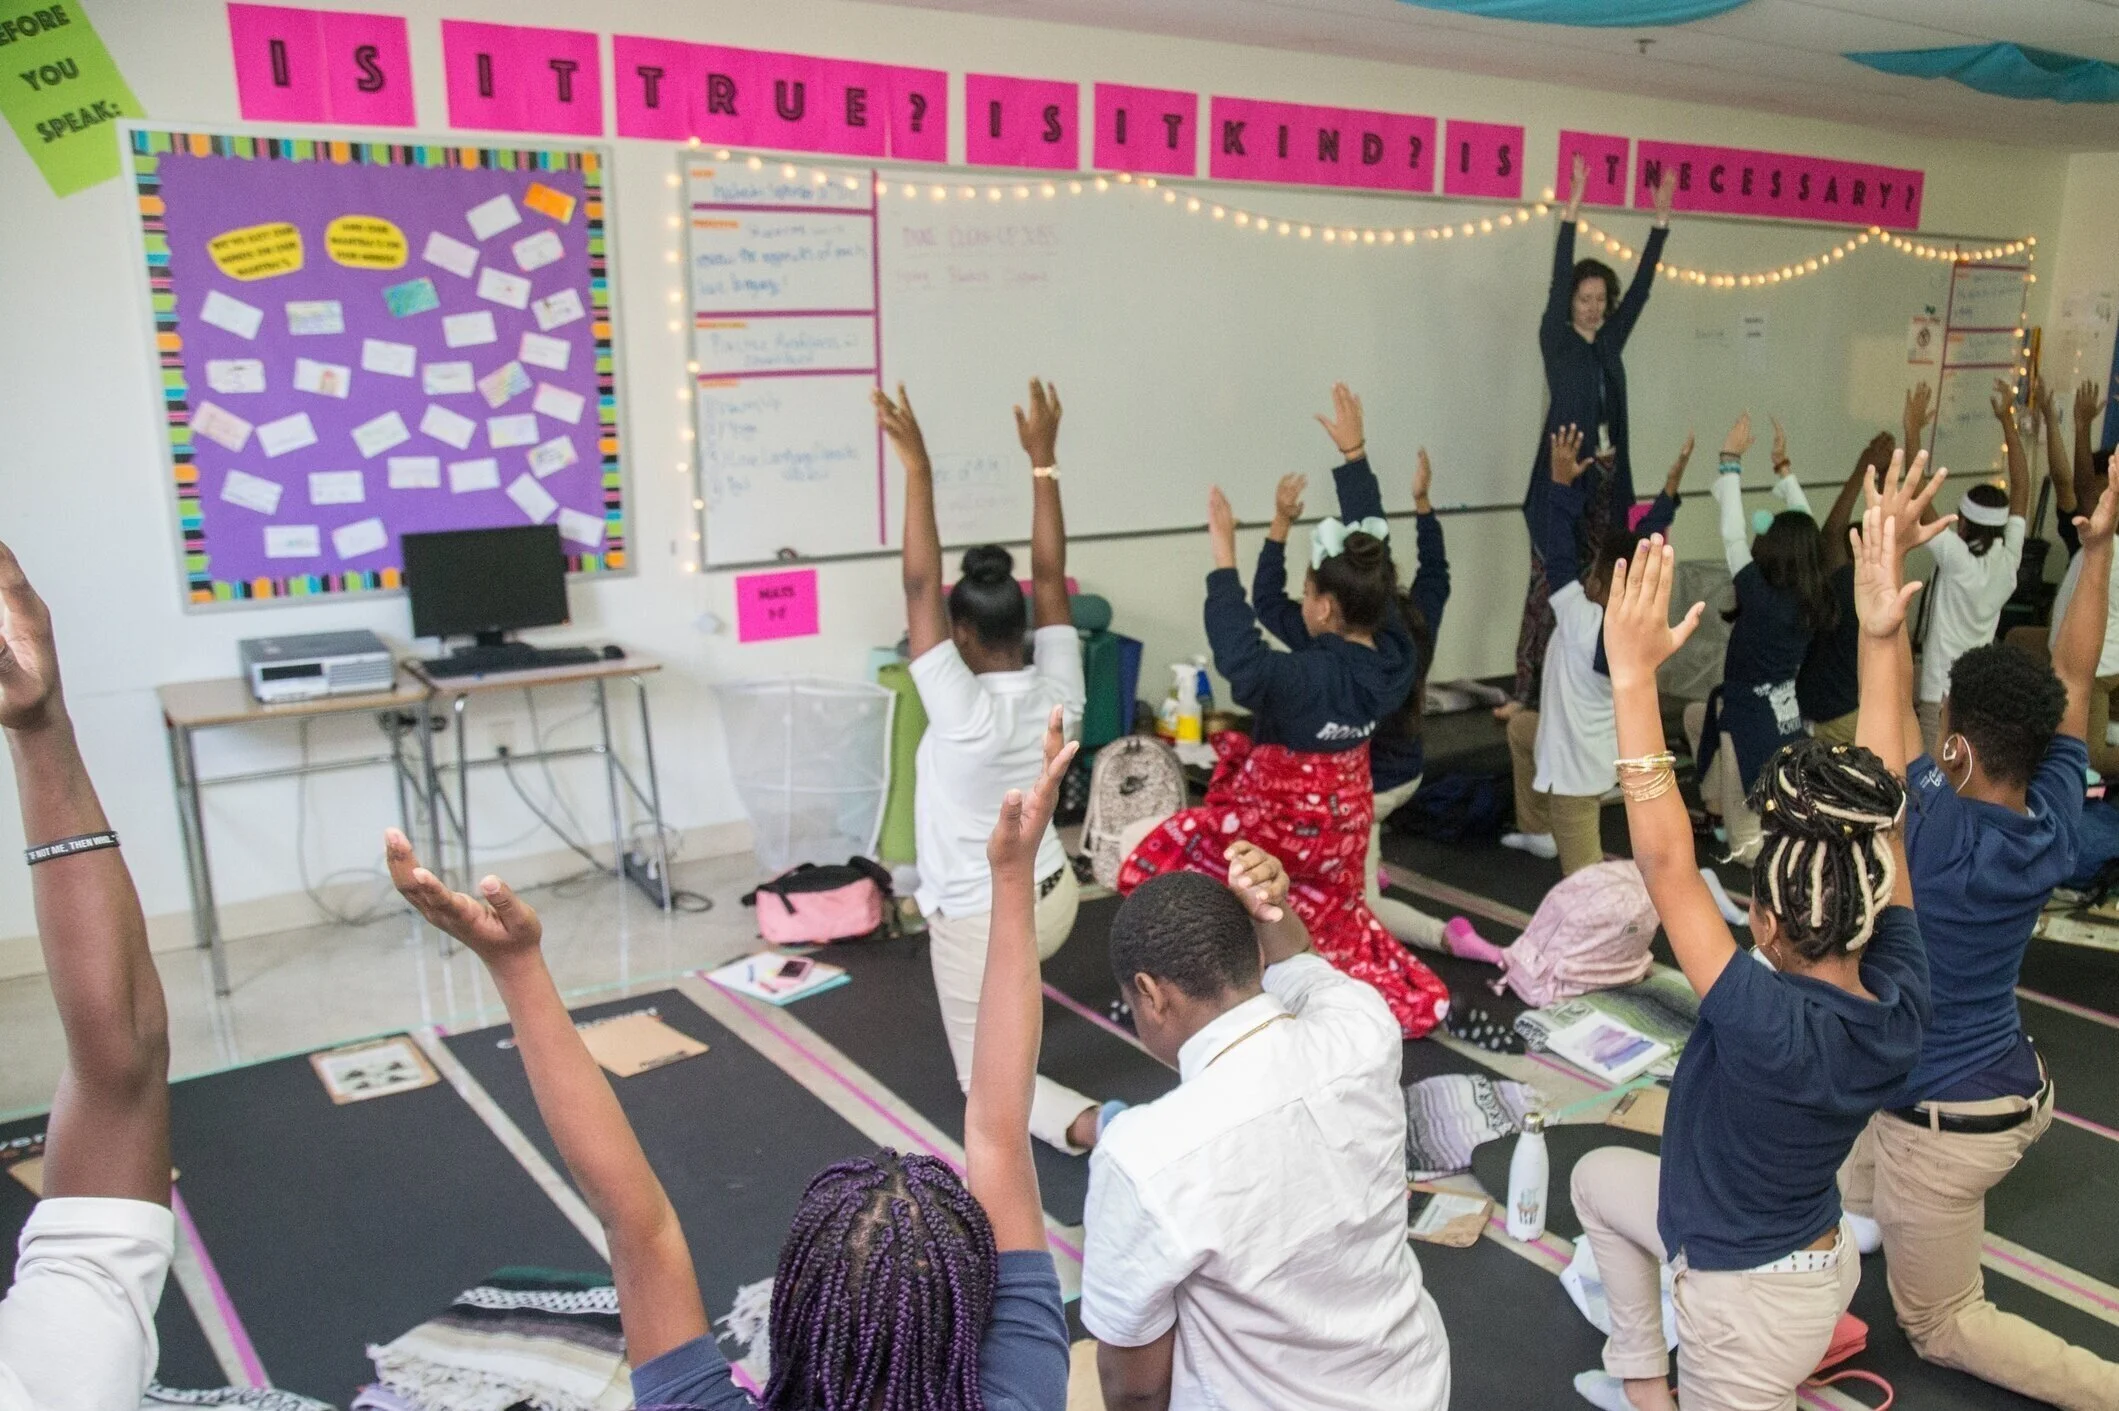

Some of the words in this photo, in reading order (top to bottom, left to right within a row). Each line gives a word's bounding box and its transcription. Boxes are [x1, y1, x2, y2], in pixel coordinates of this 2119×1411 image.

[19, 57, 80, 91] YOU
[35, 100, 122, 143] SPEAK:
[268, 38, 385, 94] IS
[476, 53, 578, 103] IT
[636, 65, 928, 133] TRUE?
[988, 100, 1063, 143] IS
[1115, 108, 1183, 150] IT
[1223, 120, 1422, 169] KIND?
[1460, 141, 1512, 177] IS
[1644, 158, 1915, 212] NECESSARY?
[36, 847, 51, 858] NOT
[69, 838, 94, 850] THEN
